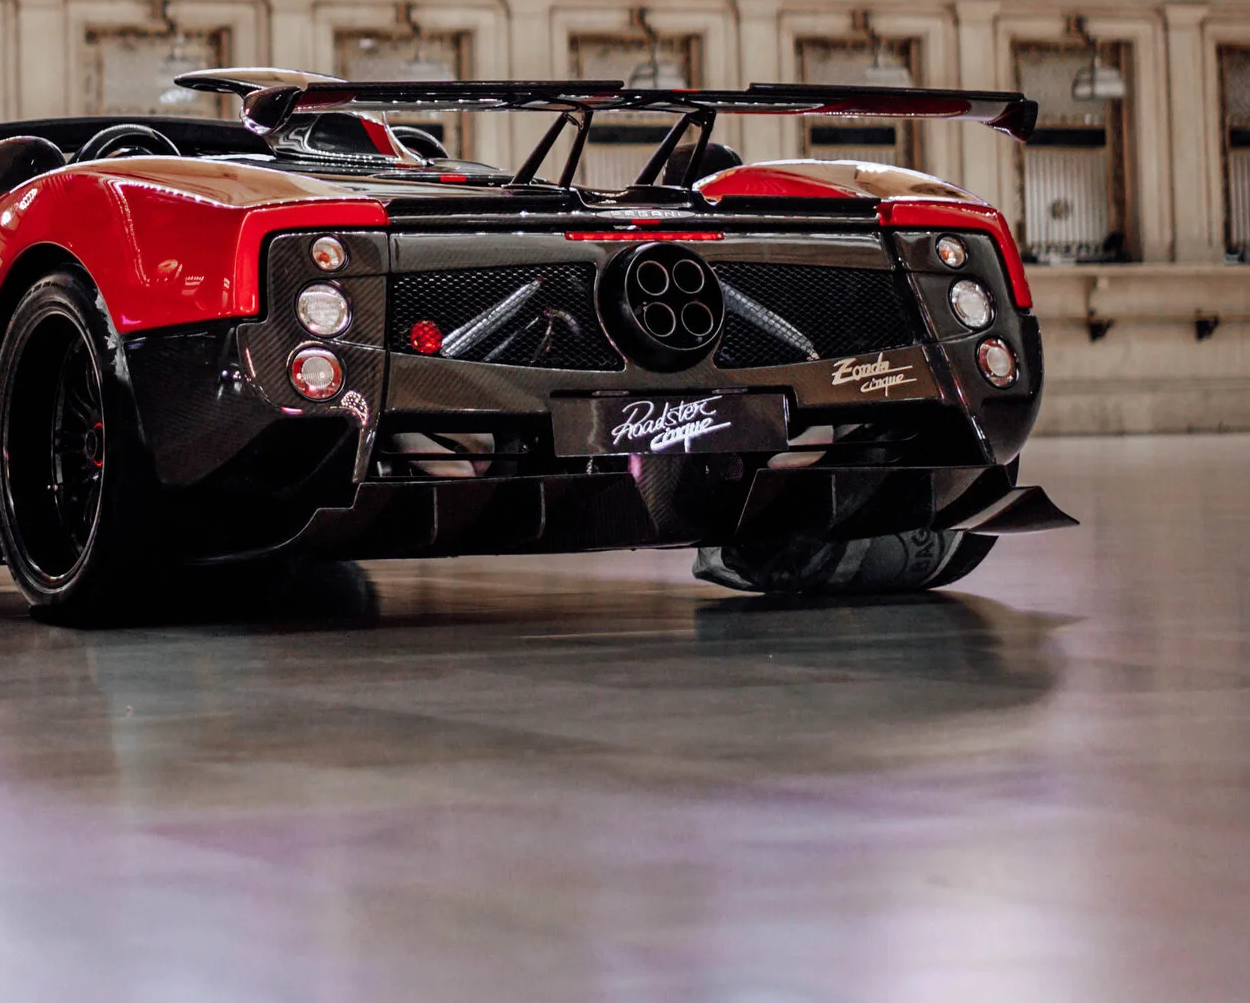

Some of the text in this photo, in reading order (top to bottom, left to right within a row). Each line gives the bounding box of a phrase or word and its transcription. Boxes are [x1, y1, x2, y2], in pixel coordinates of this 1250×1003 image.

[610, 209, 681, 218] PAGANI
[831, 352, 913, 386] Zonda
[860, 373, 917, 397] cinque
[611, 395, 723, 445] Roadster
[650, 417, 732, 453] cinque
